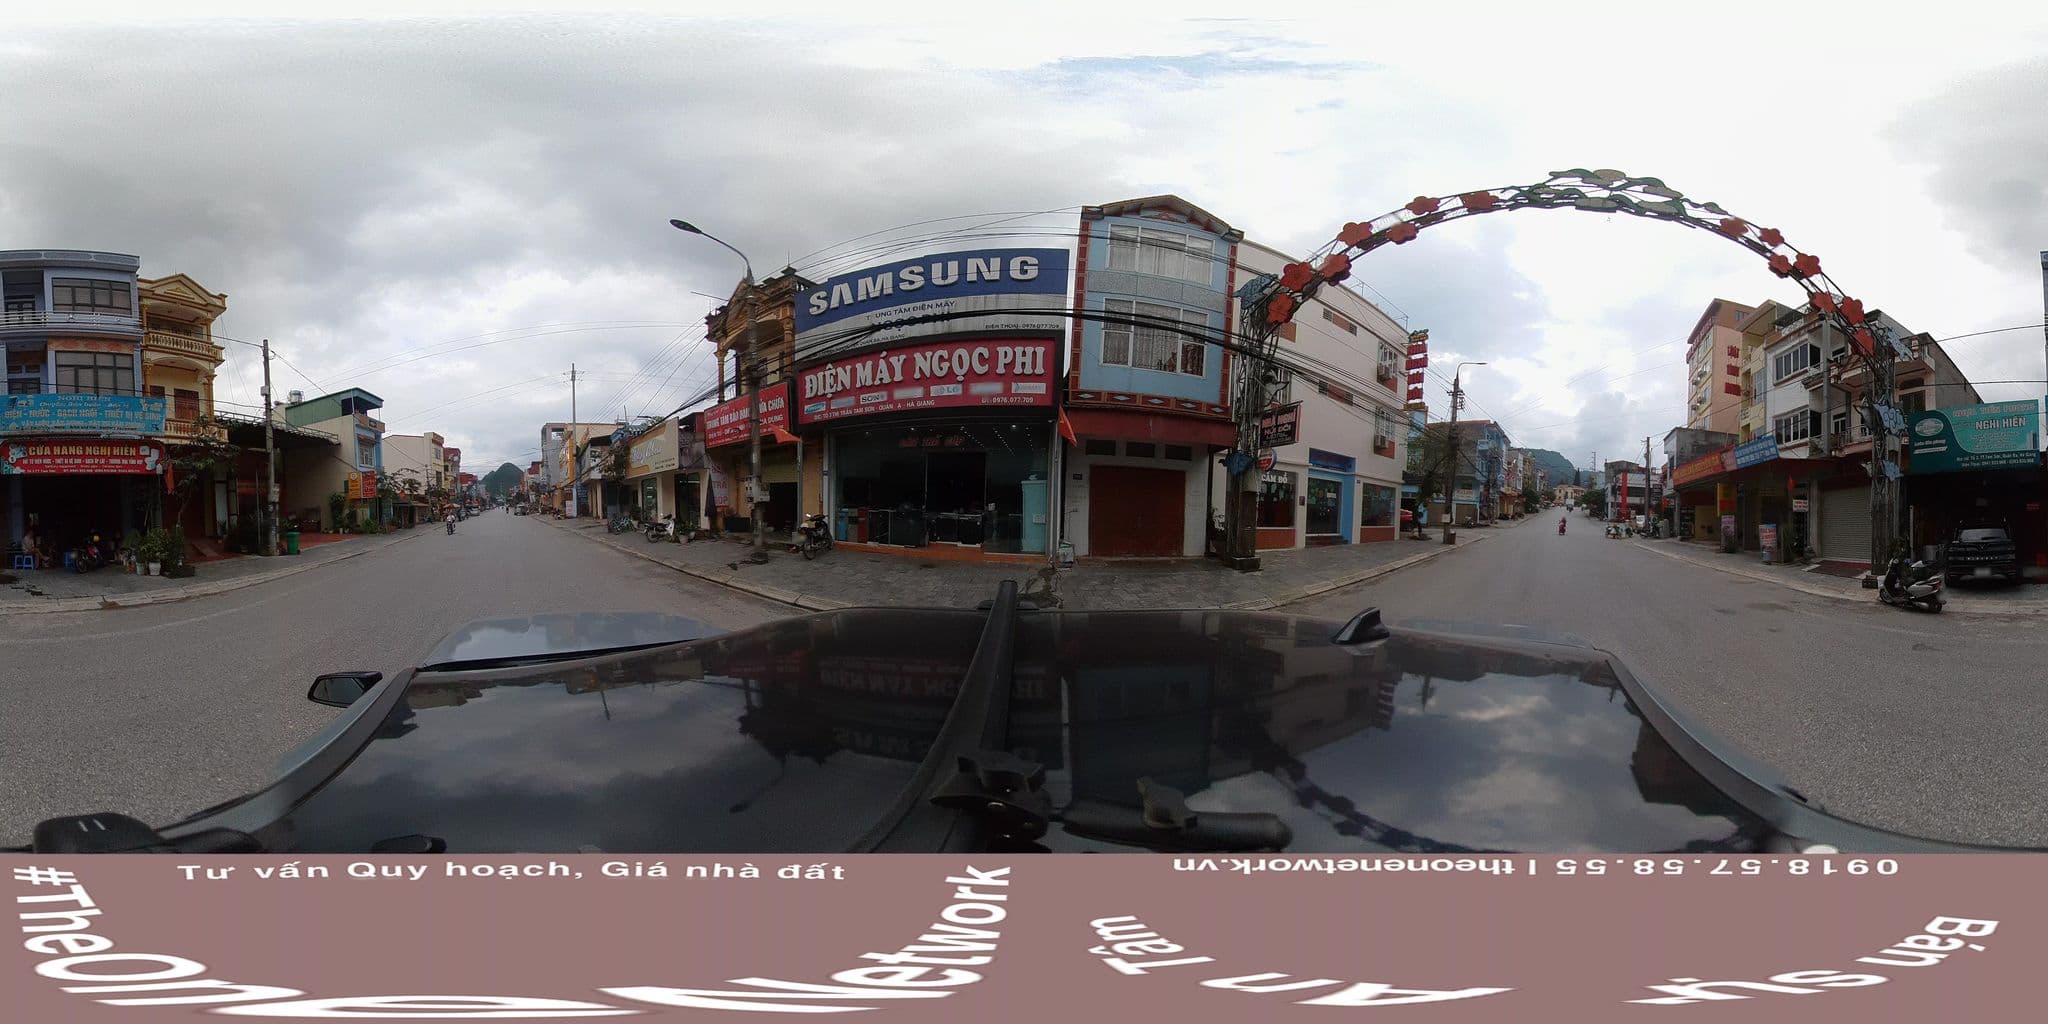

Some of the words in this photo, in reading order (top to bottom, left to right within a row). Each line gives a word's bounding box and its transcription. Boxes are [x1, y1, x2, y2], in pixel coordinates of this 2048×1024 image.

[808, 255, 1040, 316] SAMSUNG
[804, 363, 852, 399] ĐIỆN
[855, 351, 907, 390] MÁY
[913, 347, 990, 382] NGỌC
[996, 346, 1046, 376] PHI
[917, 399, 936, 407] GIANG
[1975, 419, 2000, 431] NGHỊ
[2003, 416, 2026, 429] HIỀN
[28, 444, 51, 456] CỬA
[85, 446, 111, 457] NGHỊ
